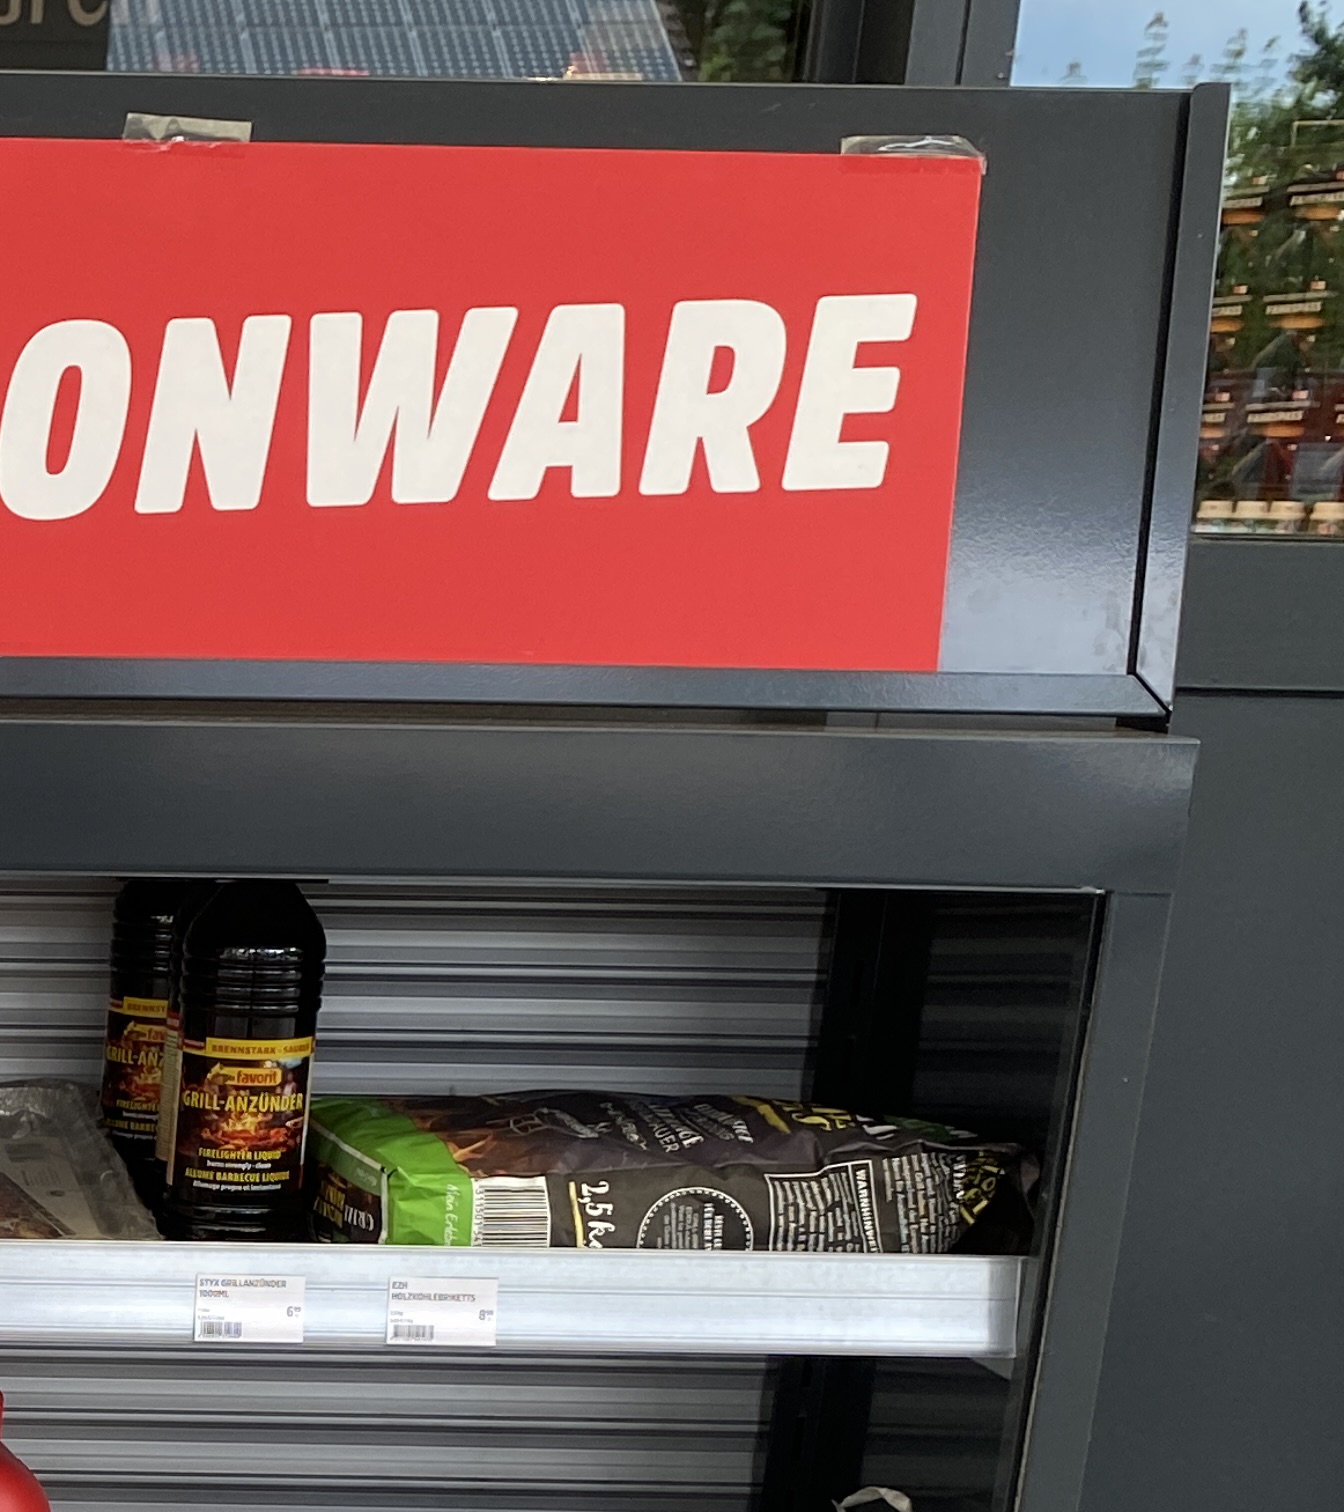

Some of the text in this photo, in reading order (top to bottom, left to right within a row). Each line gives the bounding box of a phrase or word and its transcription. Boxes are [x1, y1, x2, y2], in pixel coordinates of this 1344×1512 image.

[237, 1069, 278, 1086] favorit
[183, 1091, 304, 1113] GRILL-ANZÜNDER
[198, 1147, 252, 1160] FIRELIGHTER
[581, 1180, 612, 1217] 2,5
[199, 1278, 220, 1287] STYX
